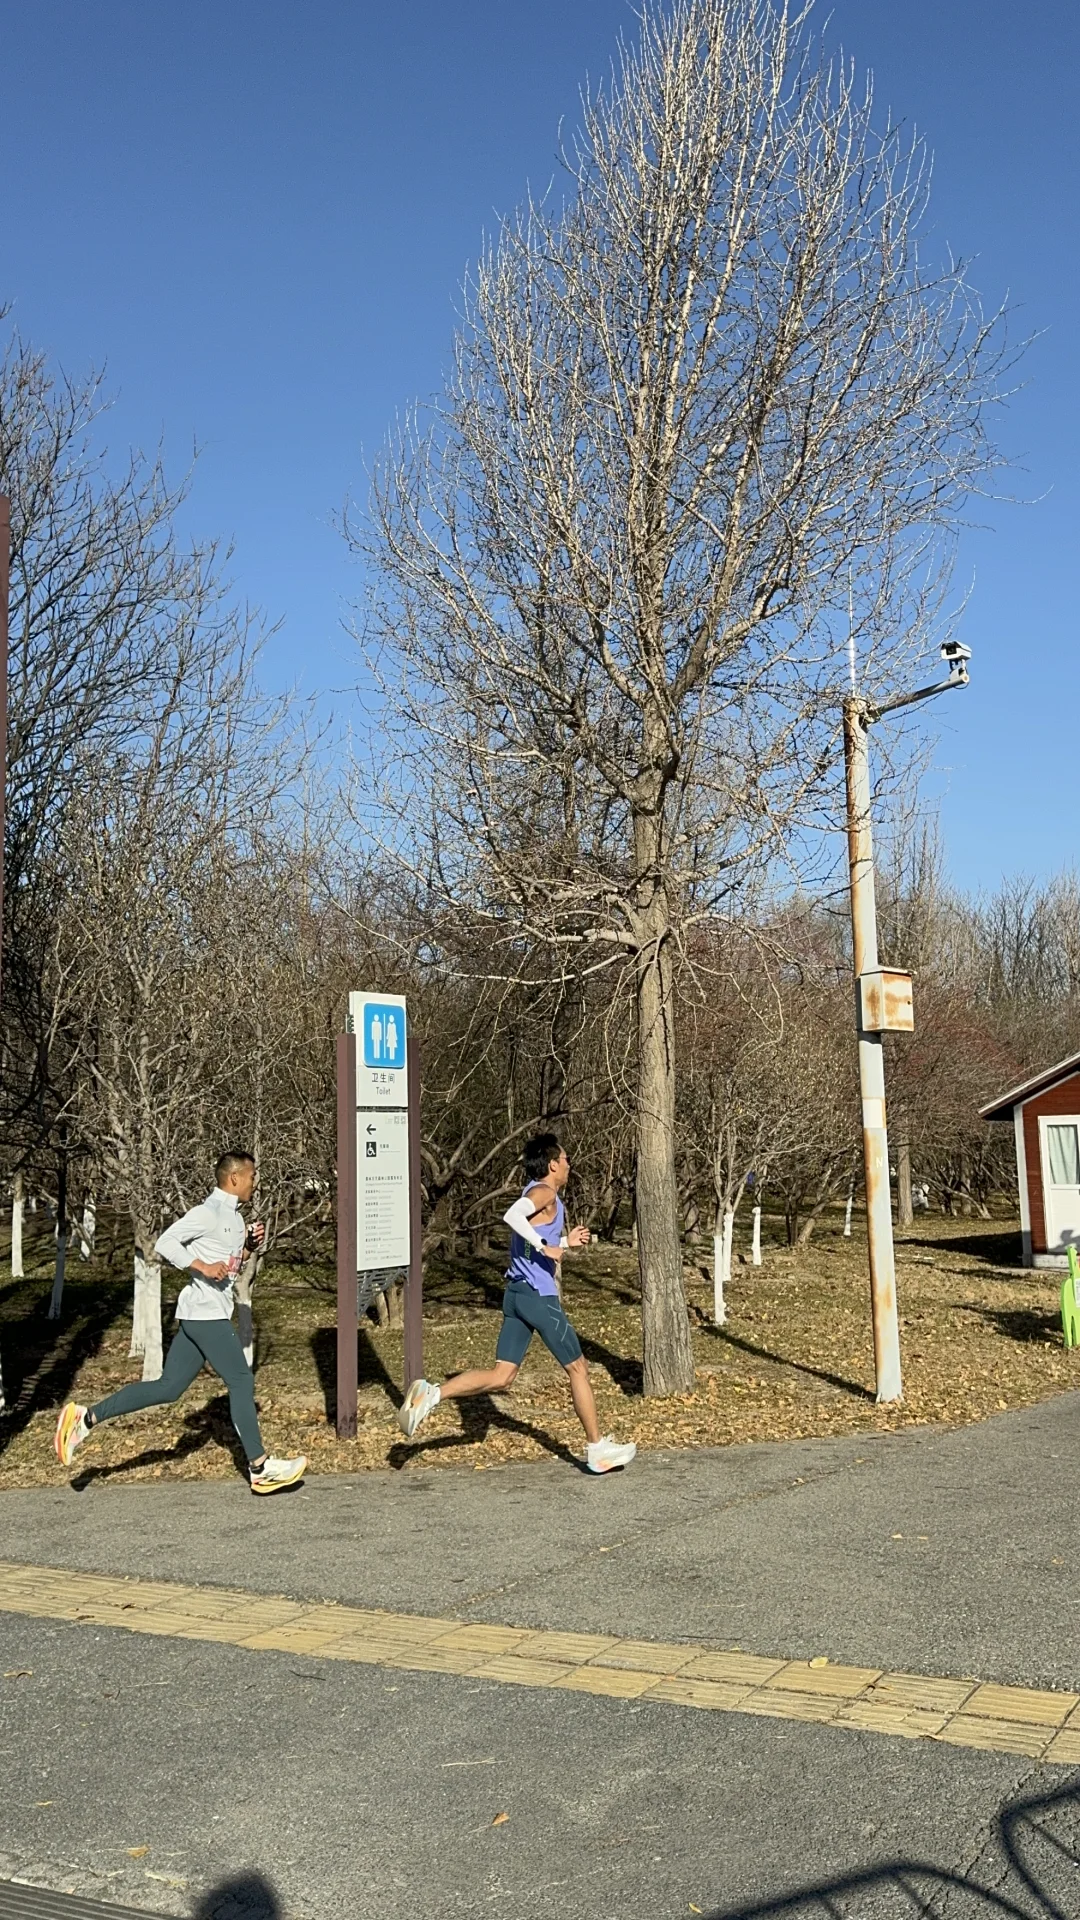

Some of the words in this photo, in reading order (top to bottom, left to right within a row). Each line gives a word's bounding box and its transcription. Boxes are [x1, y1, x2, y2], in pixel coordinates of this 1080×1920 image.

[372, 1072, 395, 1083] 卫生间
[376, 1086, 391, 1095] Toilet
